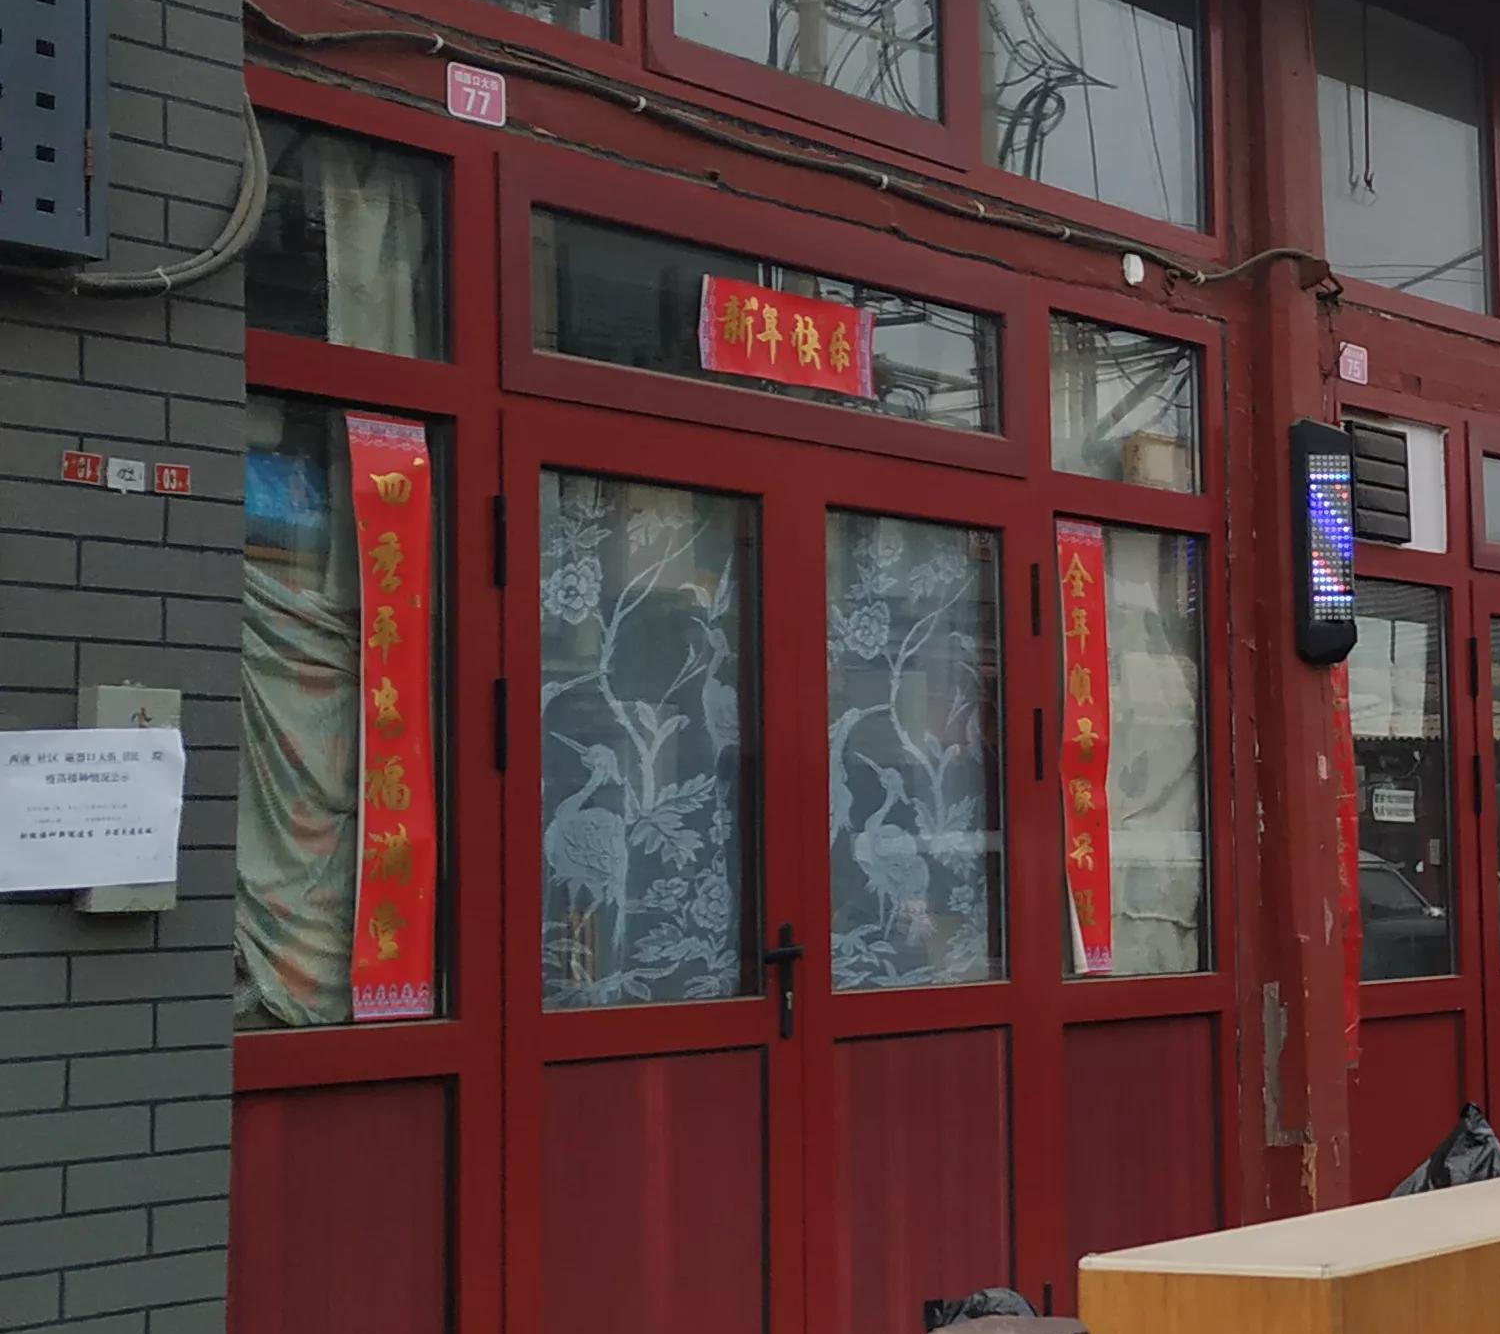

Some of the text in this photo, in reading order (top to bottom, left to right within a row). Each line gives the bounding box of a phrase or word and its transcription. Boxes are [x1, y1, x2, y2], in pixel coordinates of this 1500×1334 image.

[463, 87, 491, 116] 77
[715, 295, 851, 373] 新年快乐
